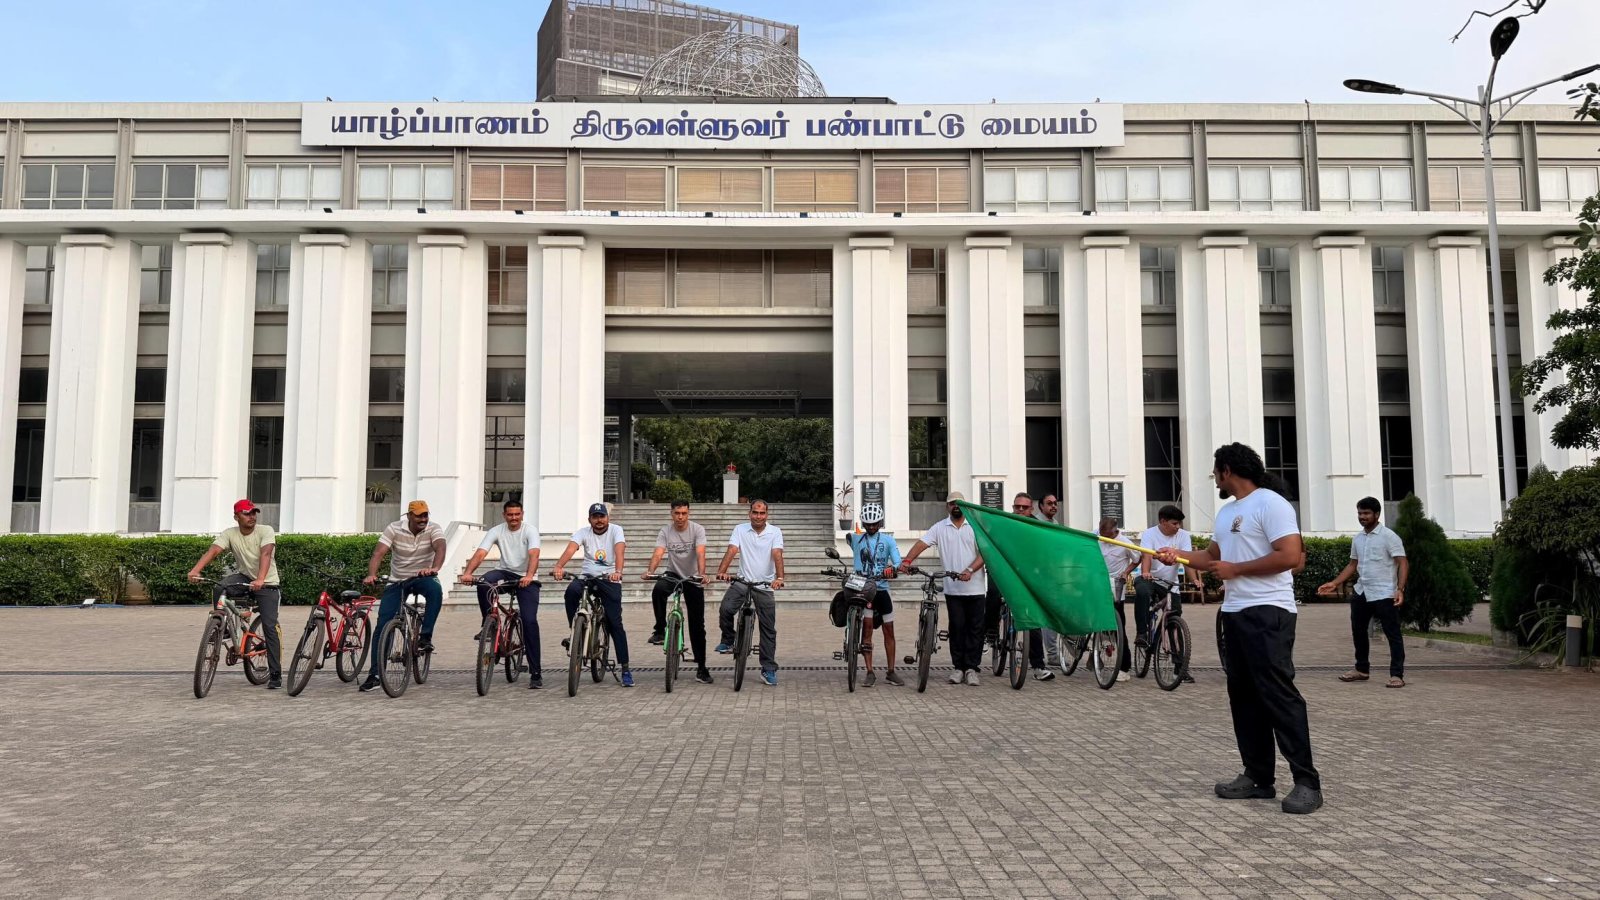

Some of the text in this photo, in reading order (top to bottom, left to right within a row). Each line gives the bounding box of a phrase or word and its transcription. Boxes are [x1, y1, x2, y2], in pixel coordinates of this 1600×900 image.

[331, 107, 1098, 141] யாழ்ப்பாணம் திருவள்ளுவர் பண்பாட்டு மையம்
